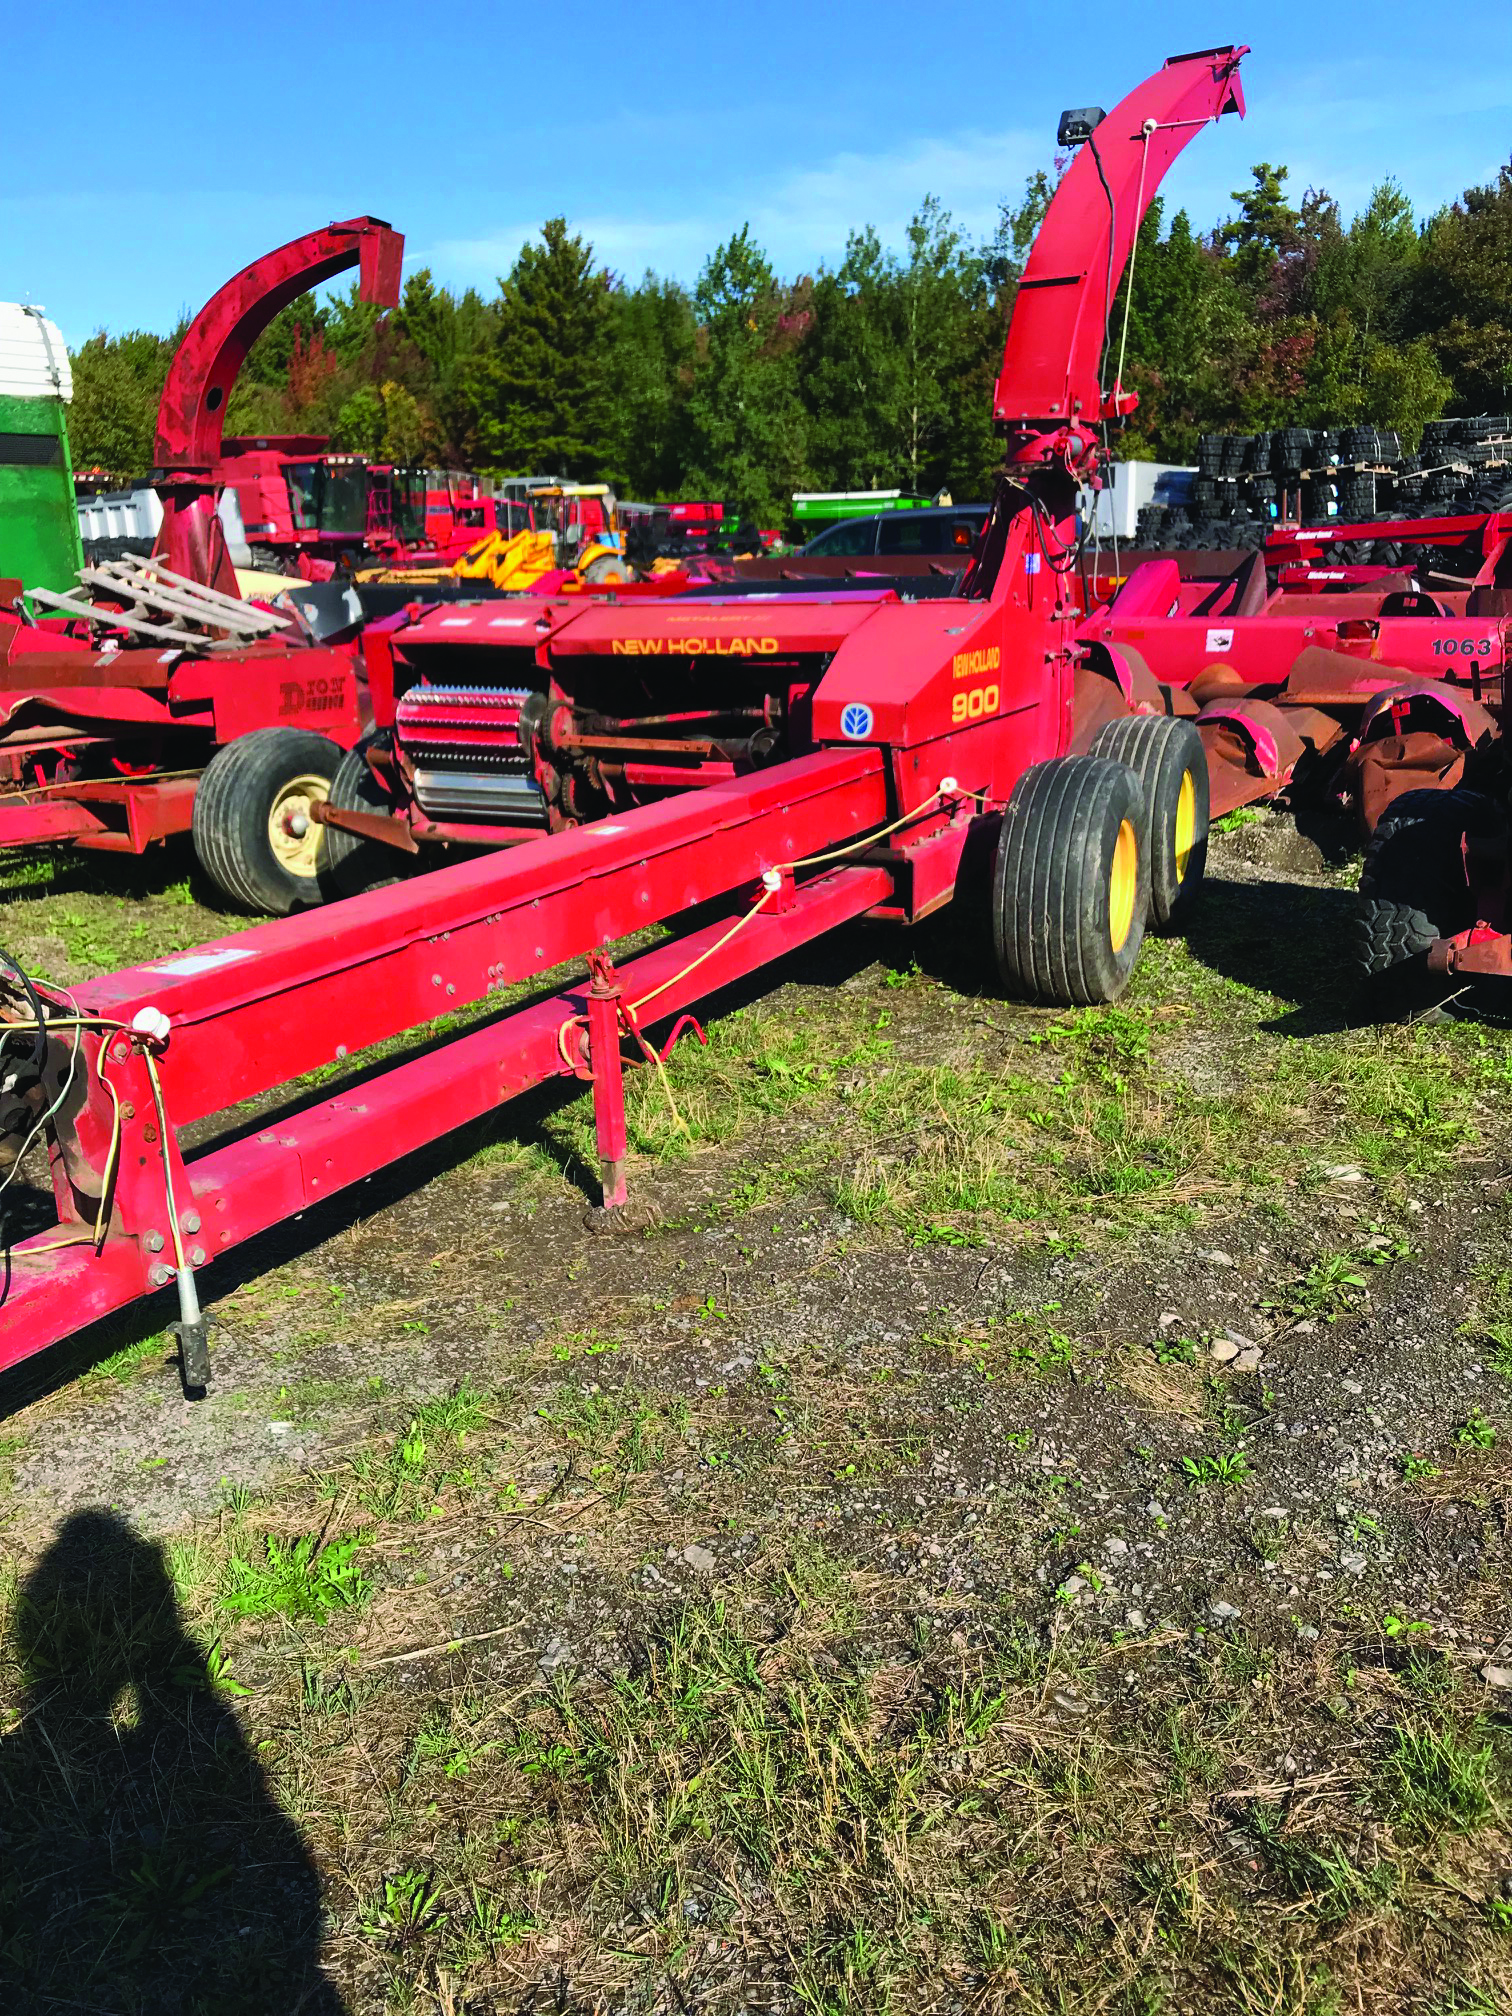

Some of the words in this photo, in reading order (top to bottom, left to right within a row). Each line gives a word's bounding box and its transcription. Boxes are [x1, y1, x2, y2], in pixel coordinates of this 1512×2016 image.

[612, 639, 662, 655] NEW
[668, 637, 779, 655] HOLLAND
[1432, 639, 1492, 656] 1063
[953, 653, 969, 679] NEW
[968, 646, 1001, 675] HOLLAND
[952, 684, 999, 723] 900
